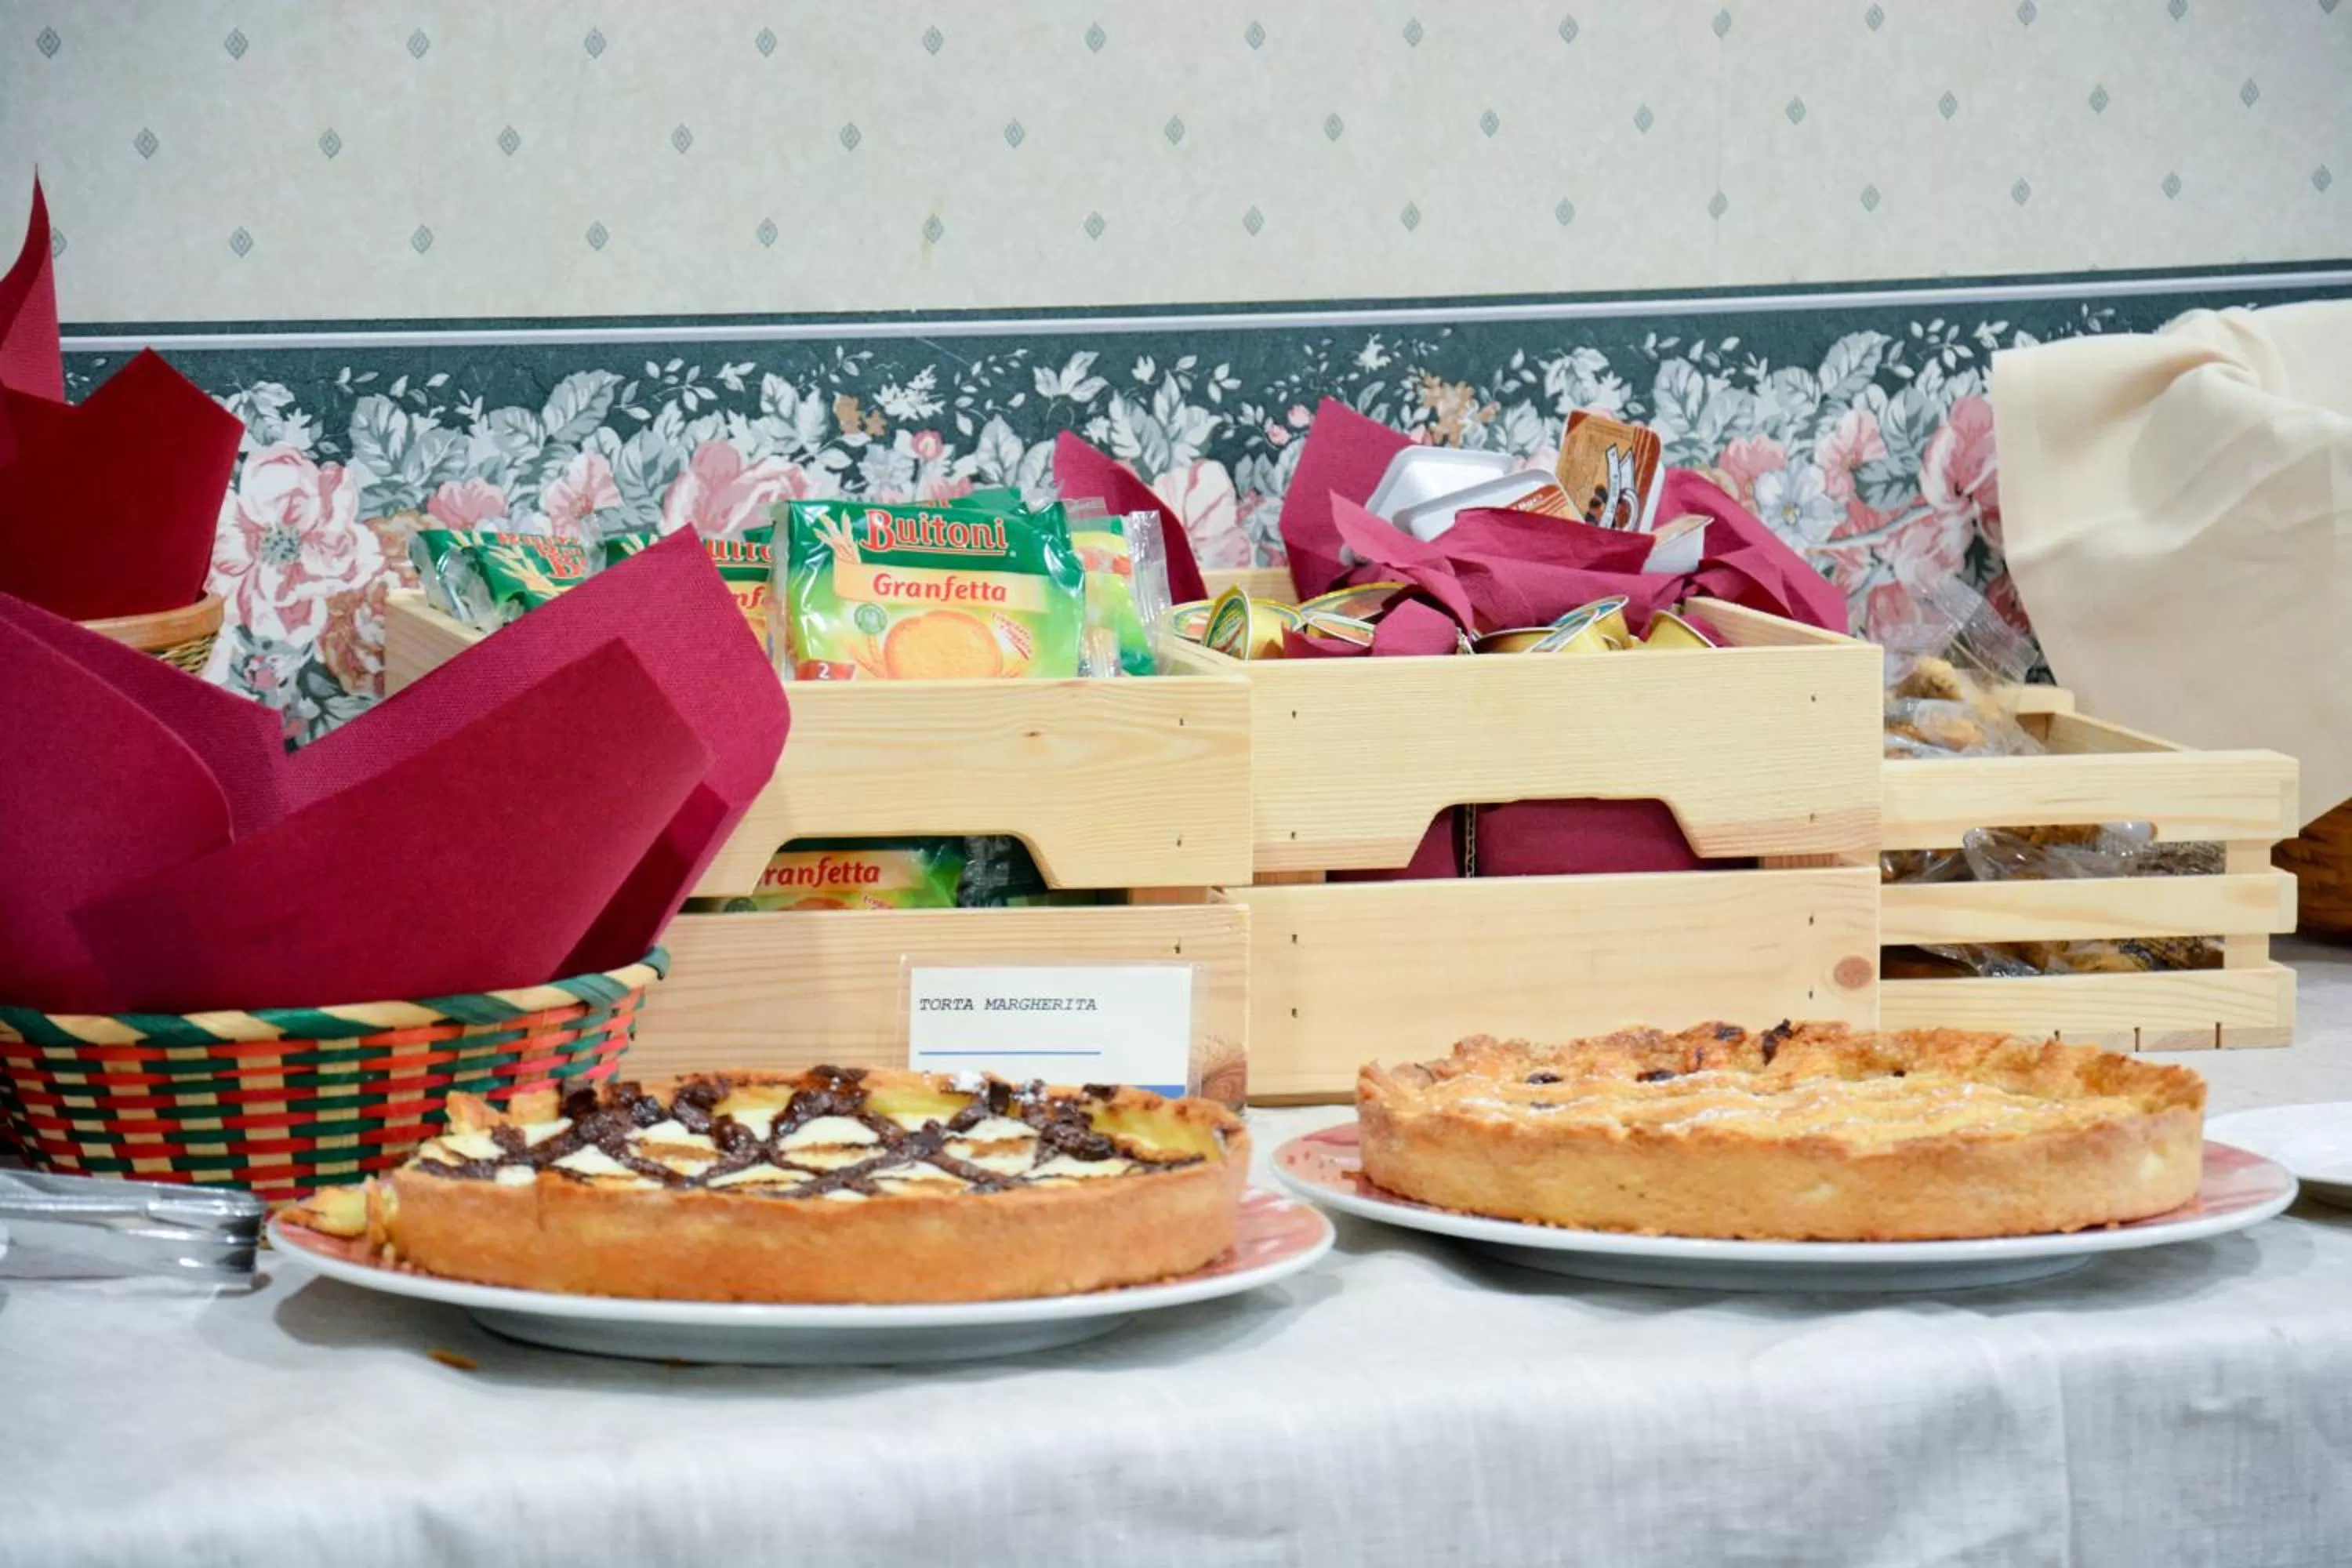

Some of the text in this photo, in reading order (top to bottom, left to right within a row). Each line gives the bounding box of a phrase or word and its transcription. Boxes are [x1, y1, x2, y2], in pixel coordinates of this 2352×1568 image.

[859, 510, 1009, 553] Buitoni
[872, 572, 1008, 602] Granfetta
[818, 662, 829, 679] 2
[758, 856, 880, 887] ranfetta
[920, 998, 1098, 1011] TORTA MARGHERITA
